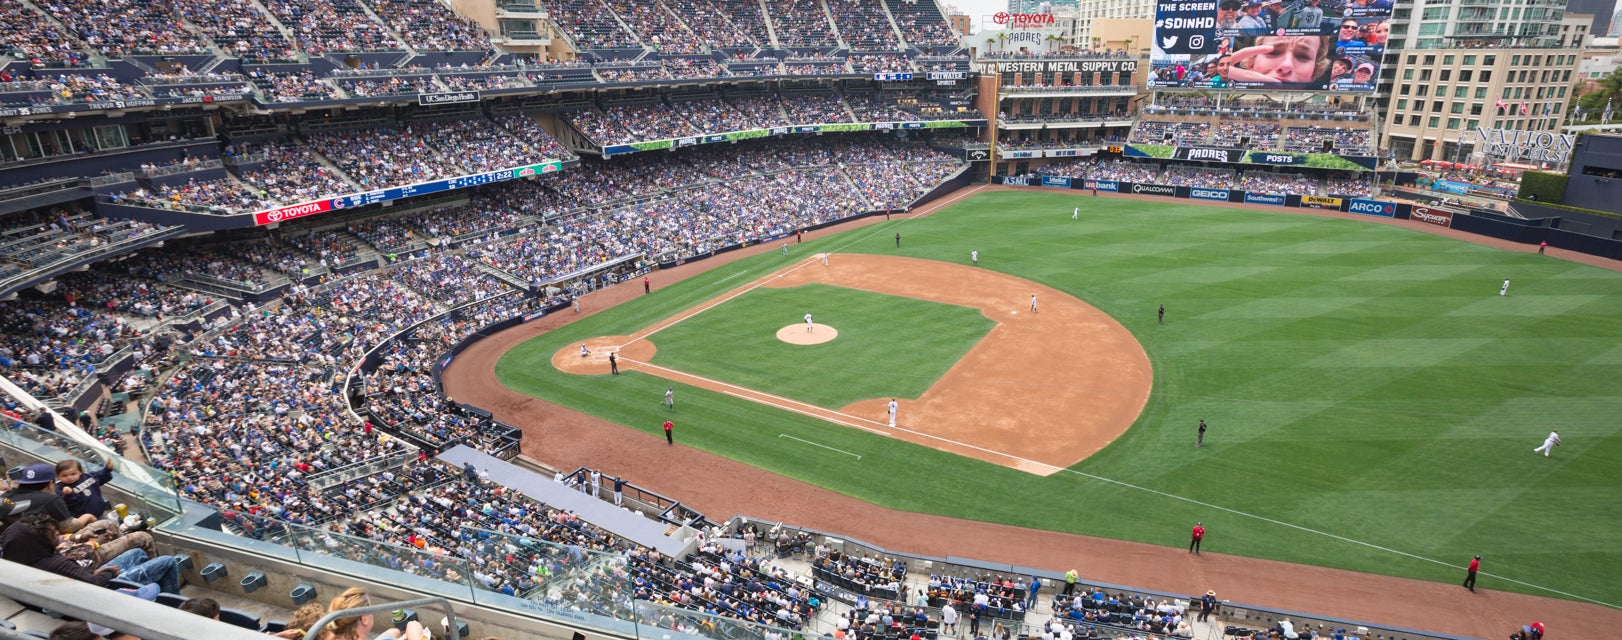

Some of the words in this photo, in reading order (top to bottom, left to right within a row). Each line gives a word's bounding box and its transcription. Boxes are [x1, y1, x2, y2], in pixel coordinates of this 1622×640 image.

[1160, 4, 1176, 12] THE
[1179, 2, 1215, 11] SCREEN
[1012, 13, 1055, 24] TOYOTA
[1155, 17, 1215, 29] #SDINHD
[1008, 31, 1041, 46] PADRES
[998, 62, 1044, 73] WESTERN
[1048, 61, 1080, 73] METAL
[1082, 61, 1118, 72] SUPPLY
[1121, 61, 1137, 72] CO.
[931, 72, 962, 80] CUTWATER
[87, 102, 115, 110] TREVOR
[116, 101, 126, 109] 51
[18, 107, 31, 116] 35
[1187, 148, 1228, 162] PADRES
[1266, 154, 1293, 163] POSTS
[496, 170, 513, 180] 2:22
[1003, 176, 1030, 186] ASML
[1133, 184, 1174, 194] QUALCOMM
[1191, 189, 1228, 200] GEICO
[1247, 194, 1278, 203] Southwest
[282, 202, 321, 218] TOYOTA
[1351, 202, 1383, 213] ARCO
[1415, 208, 1447, 222] Sycuan
